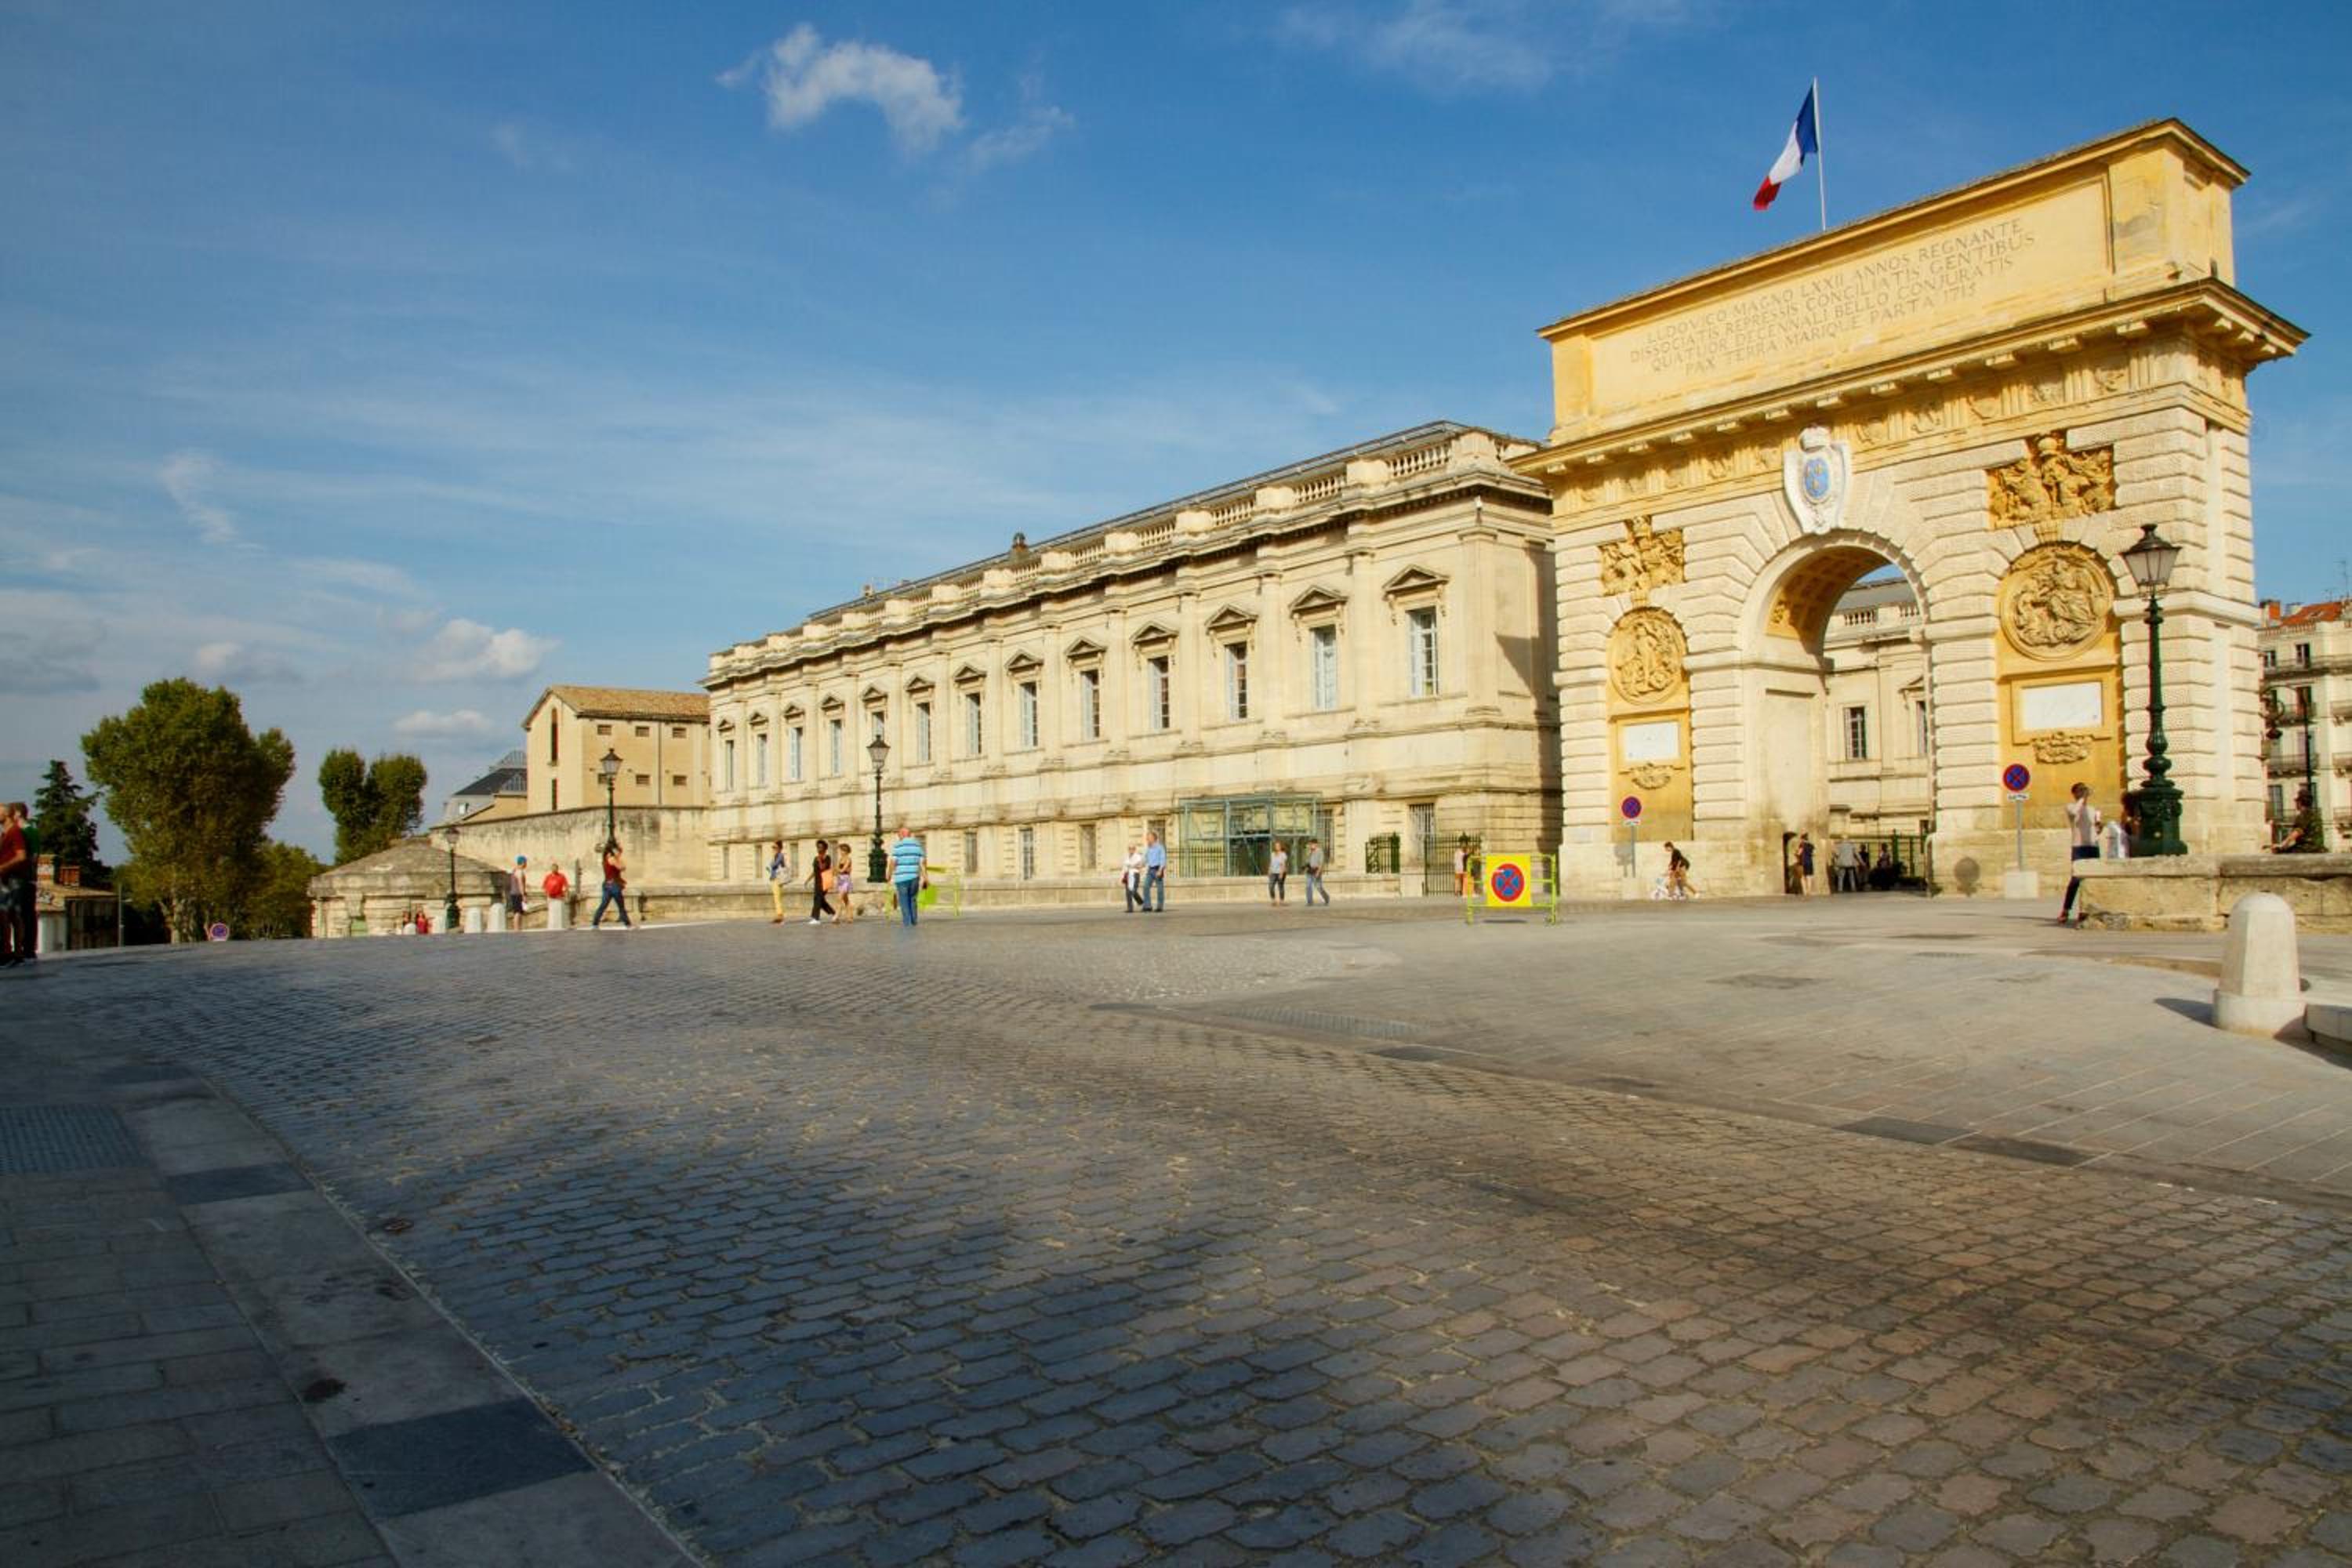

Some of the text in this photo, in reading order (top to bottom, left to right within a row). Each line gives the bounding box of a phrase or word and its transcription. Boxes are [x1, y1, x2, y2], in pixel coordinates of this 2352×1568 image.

[1646, 218, 2022, 343] LUDOVICO MAGNO LXXII ANNOS REGNANTE
[1806, 265, 1920, 311] CONCILIATIS
[1930, 234, 2034, 274] GENTIBUS
[1835, 292, 1889, 318] BELLO
[1898, 256, 2013, 299] CONJURATIS
[1686, 281, 1976, 377] PAX TERRA MARIQUE PARTA 1715
